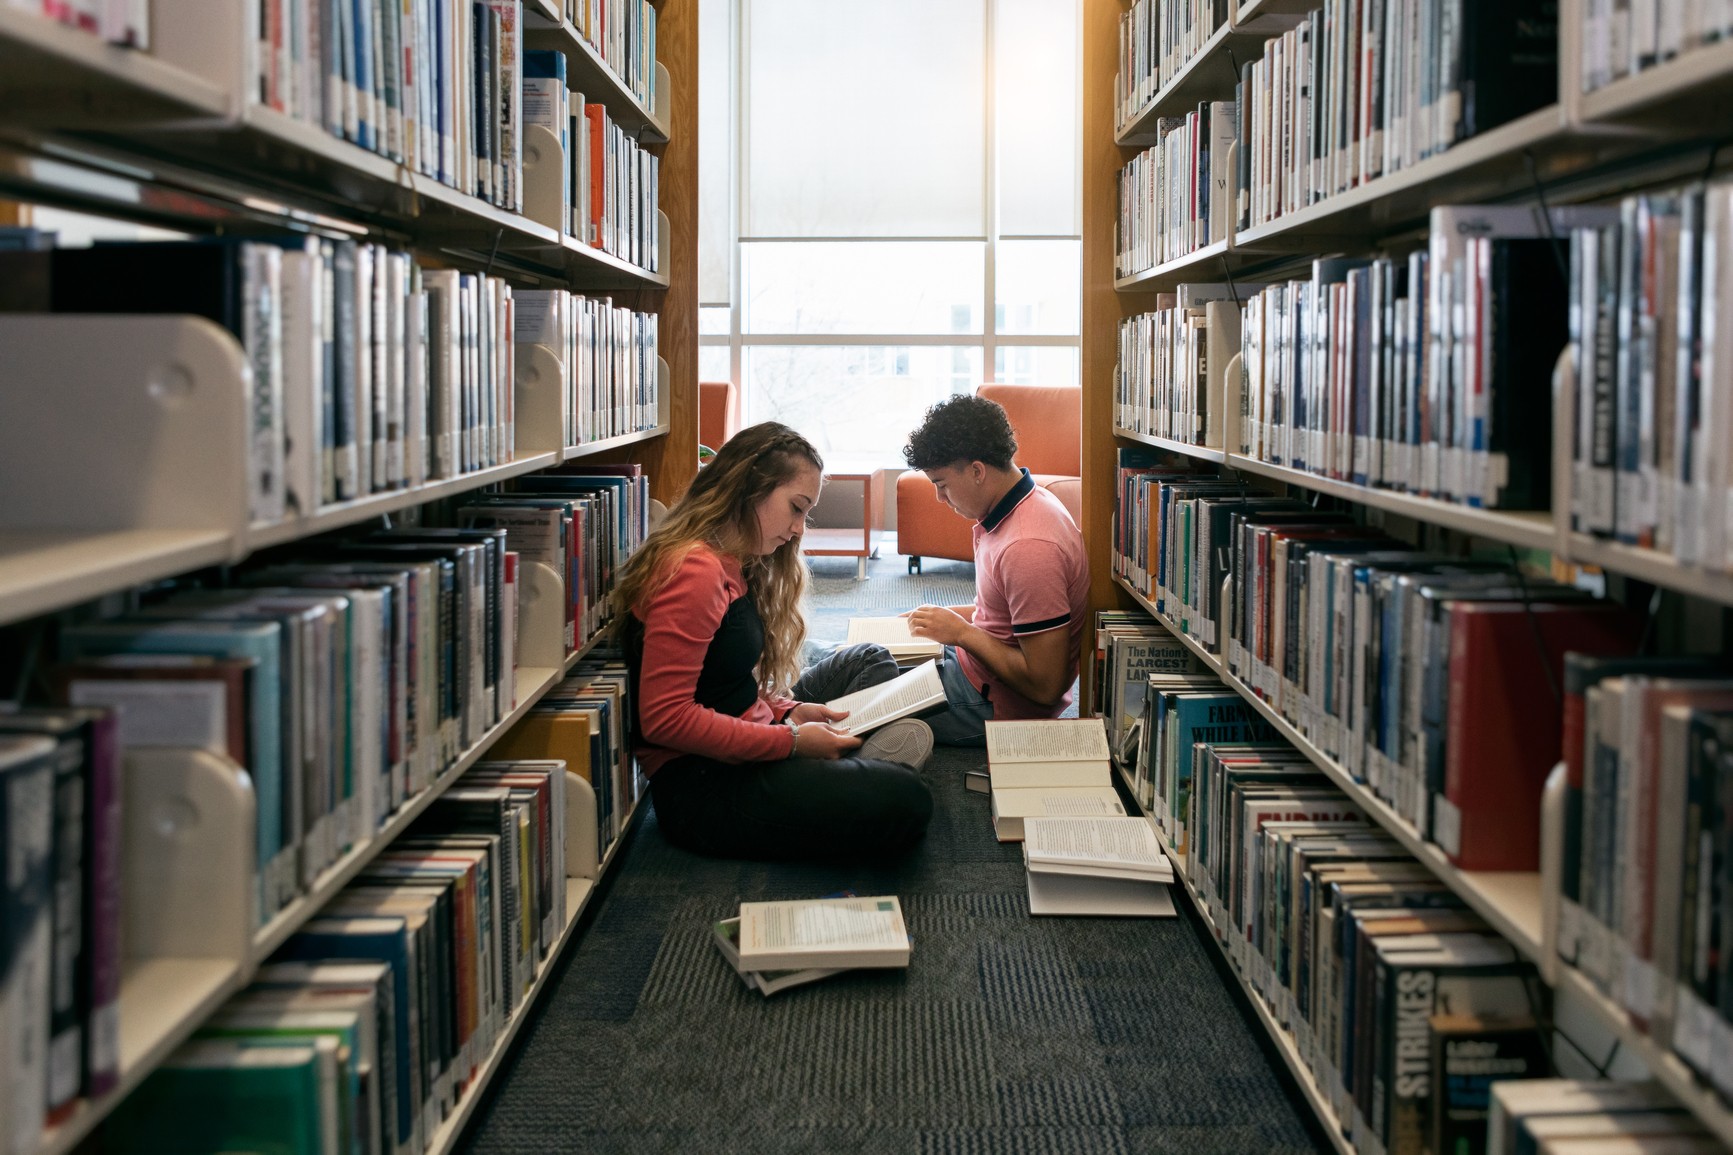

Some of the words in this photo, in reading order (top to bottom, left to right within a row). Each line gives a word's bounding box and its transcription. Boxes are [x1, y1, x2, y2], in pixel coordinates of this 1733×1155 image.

[1127, 646, 1146, 657] The
[1148, 646, 1189, 658] Nation's
[1127, 658, 1189, 668] LARGEST
[1191, 726, 1239, 743] WHILE
[1395, 969, 1436, 1099] STRIKES
